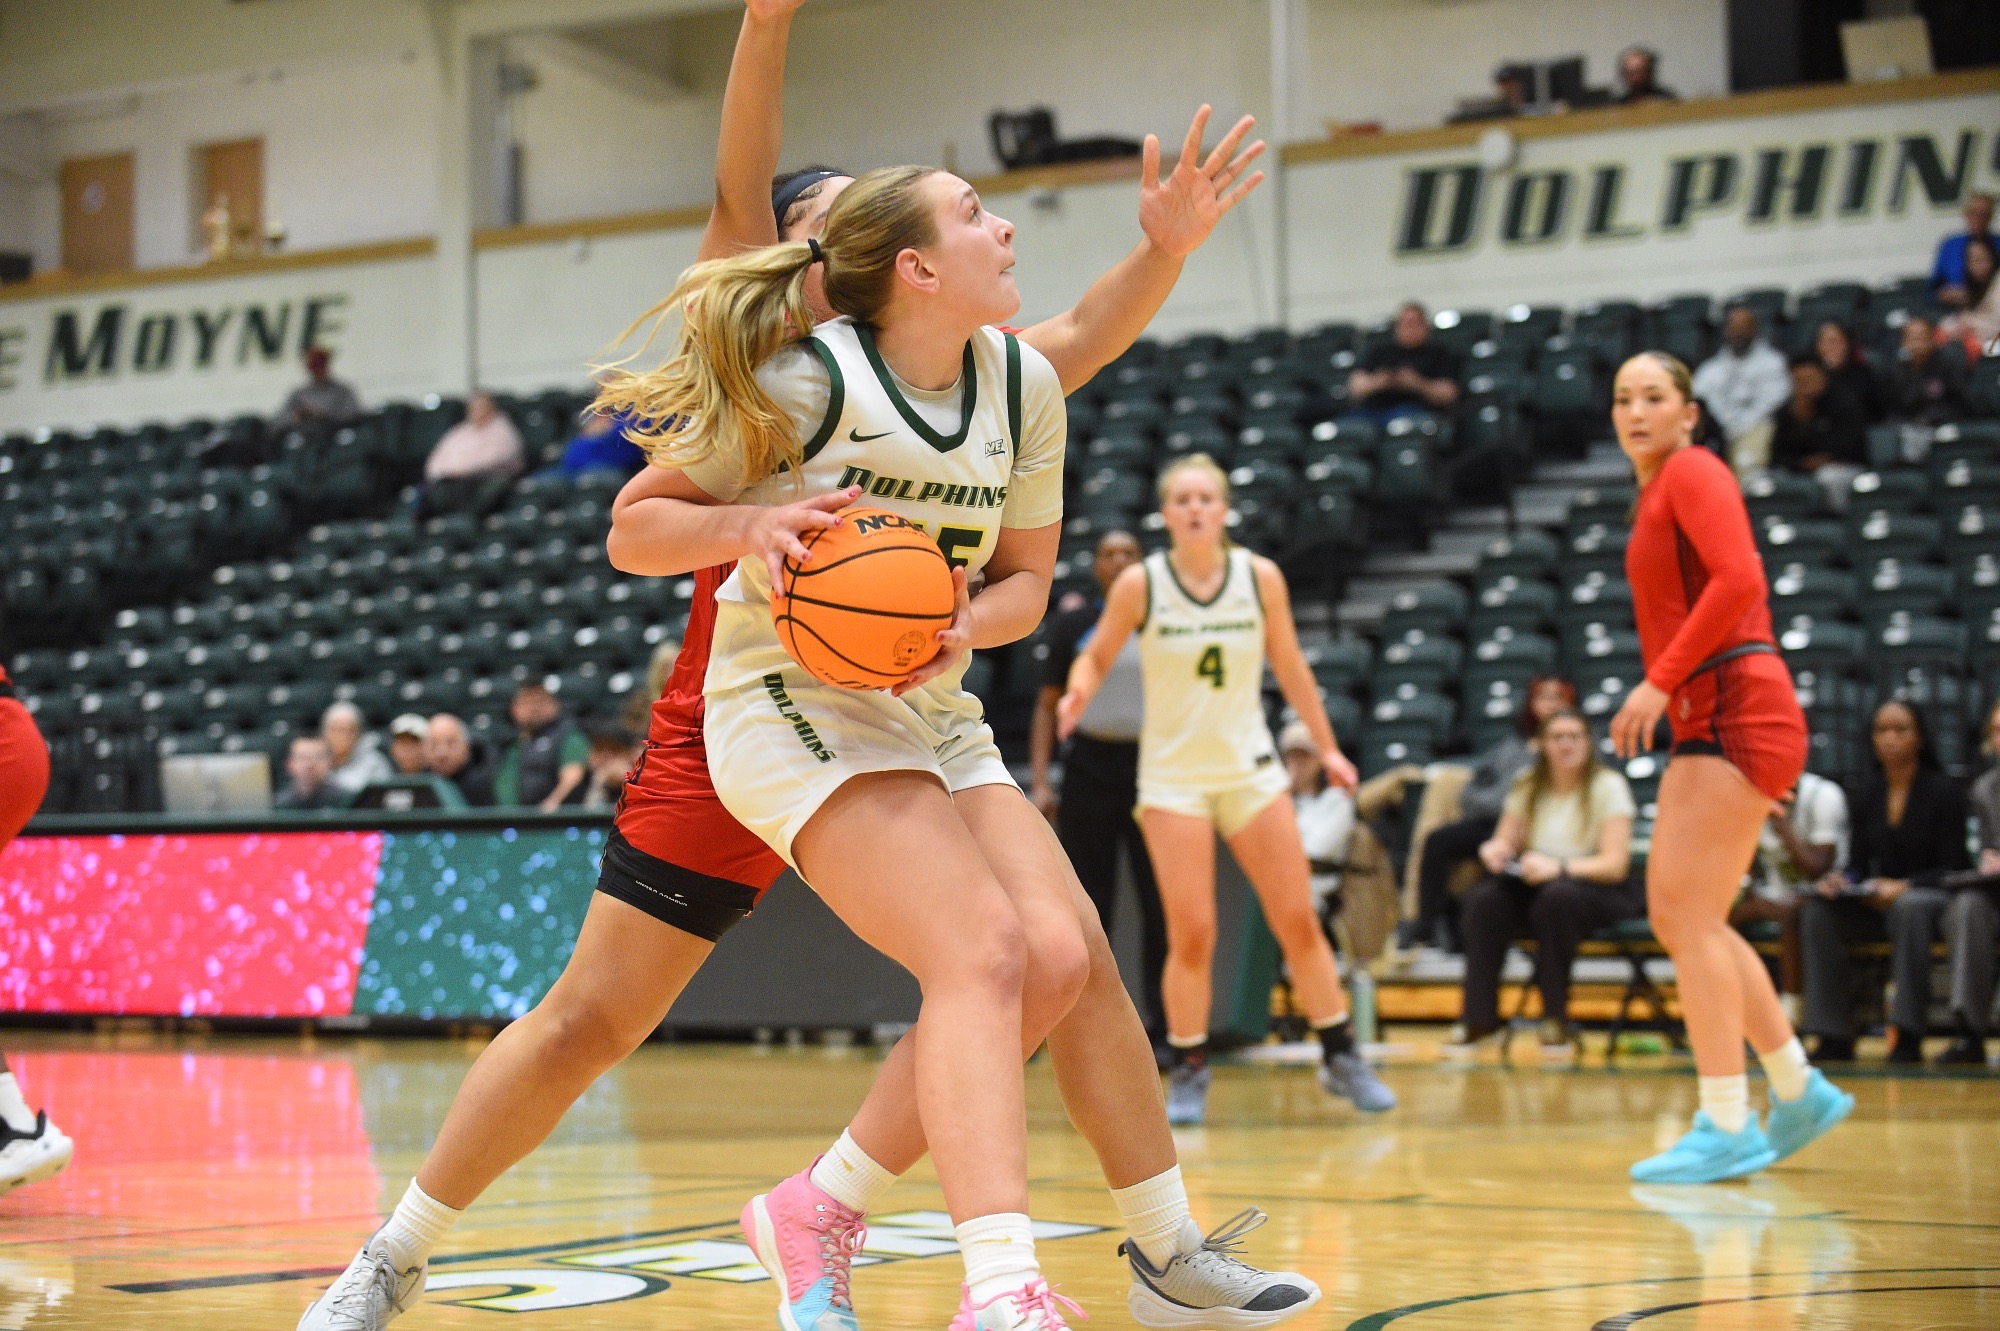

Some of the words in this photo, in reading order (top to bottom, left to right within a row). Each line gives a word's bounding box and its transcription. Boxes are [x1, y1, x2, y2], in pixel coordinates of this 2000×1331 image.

[1393, 127, 2000, 259] DOLPHIN
[42, 294, 350, 390] MOYNE
[836, 465, 1007, 509] DOLPHINS
[1195, 645, 1224, 690] 4
[763, 672, 837, 763] DOLPHINS
